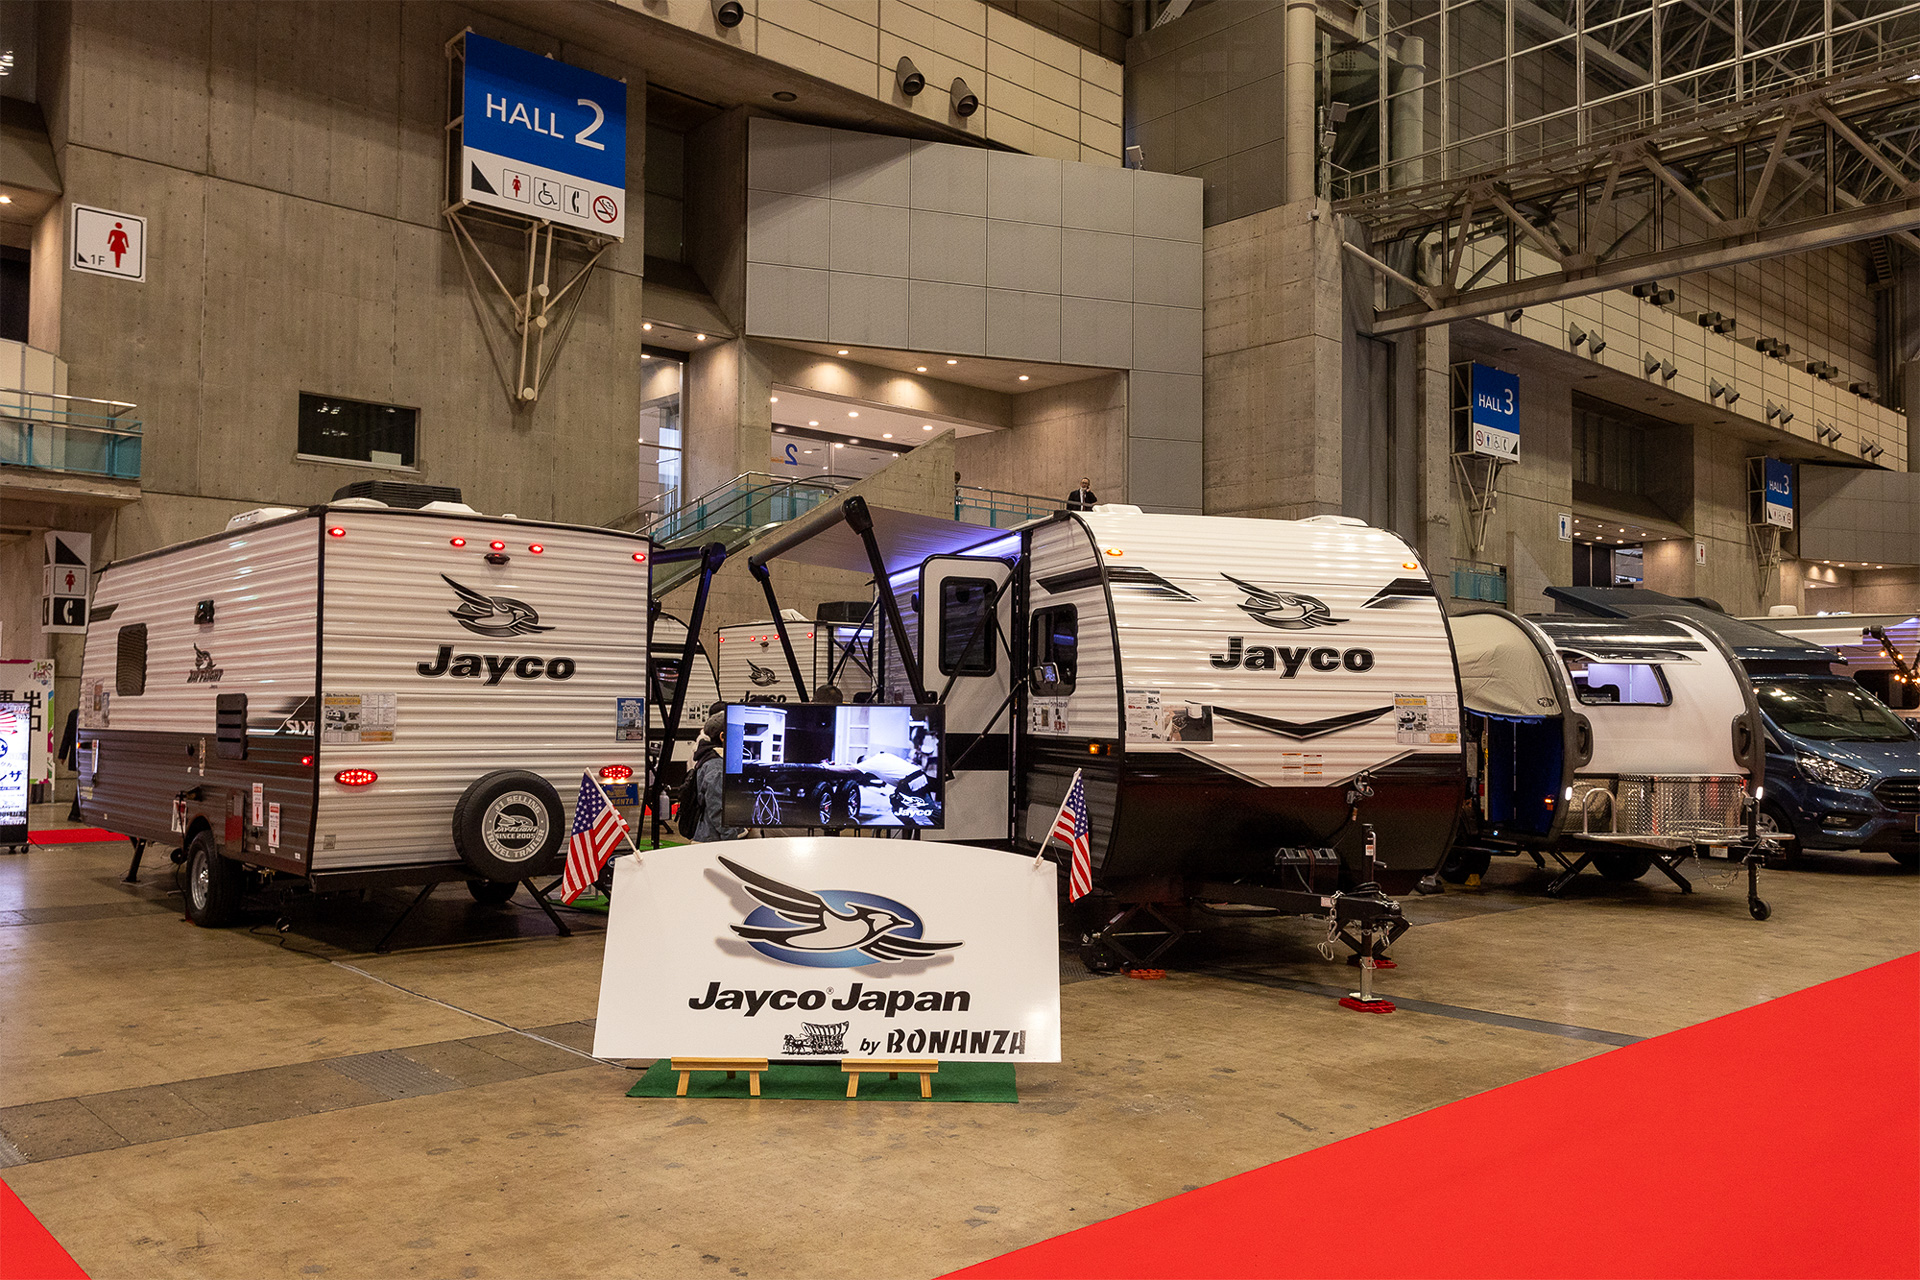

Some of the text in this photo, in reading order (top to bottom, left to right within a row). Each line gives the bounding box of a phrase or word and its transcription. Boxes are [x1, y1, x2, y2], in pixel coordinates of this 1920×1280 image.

[485, 92, 606, 151] HALL 2
[90, 254, 106, 266] 1F
[1478, 388, 1514, 416] HALL 3
[1769, 474, 1790, 496] HALL 3
[416, 644, 576, 686] Jayco
[1210, 636, 1375, 679] Jayco
[506, 795, 542, 814] SELLING
[894, 807, 933, 818] Jayco
[486, 829, 545, 858] TRAVEL TRAILER
[831, 982, 971, 1018] Japan
[858, 1028, 1027, 1056] by BONANZA
